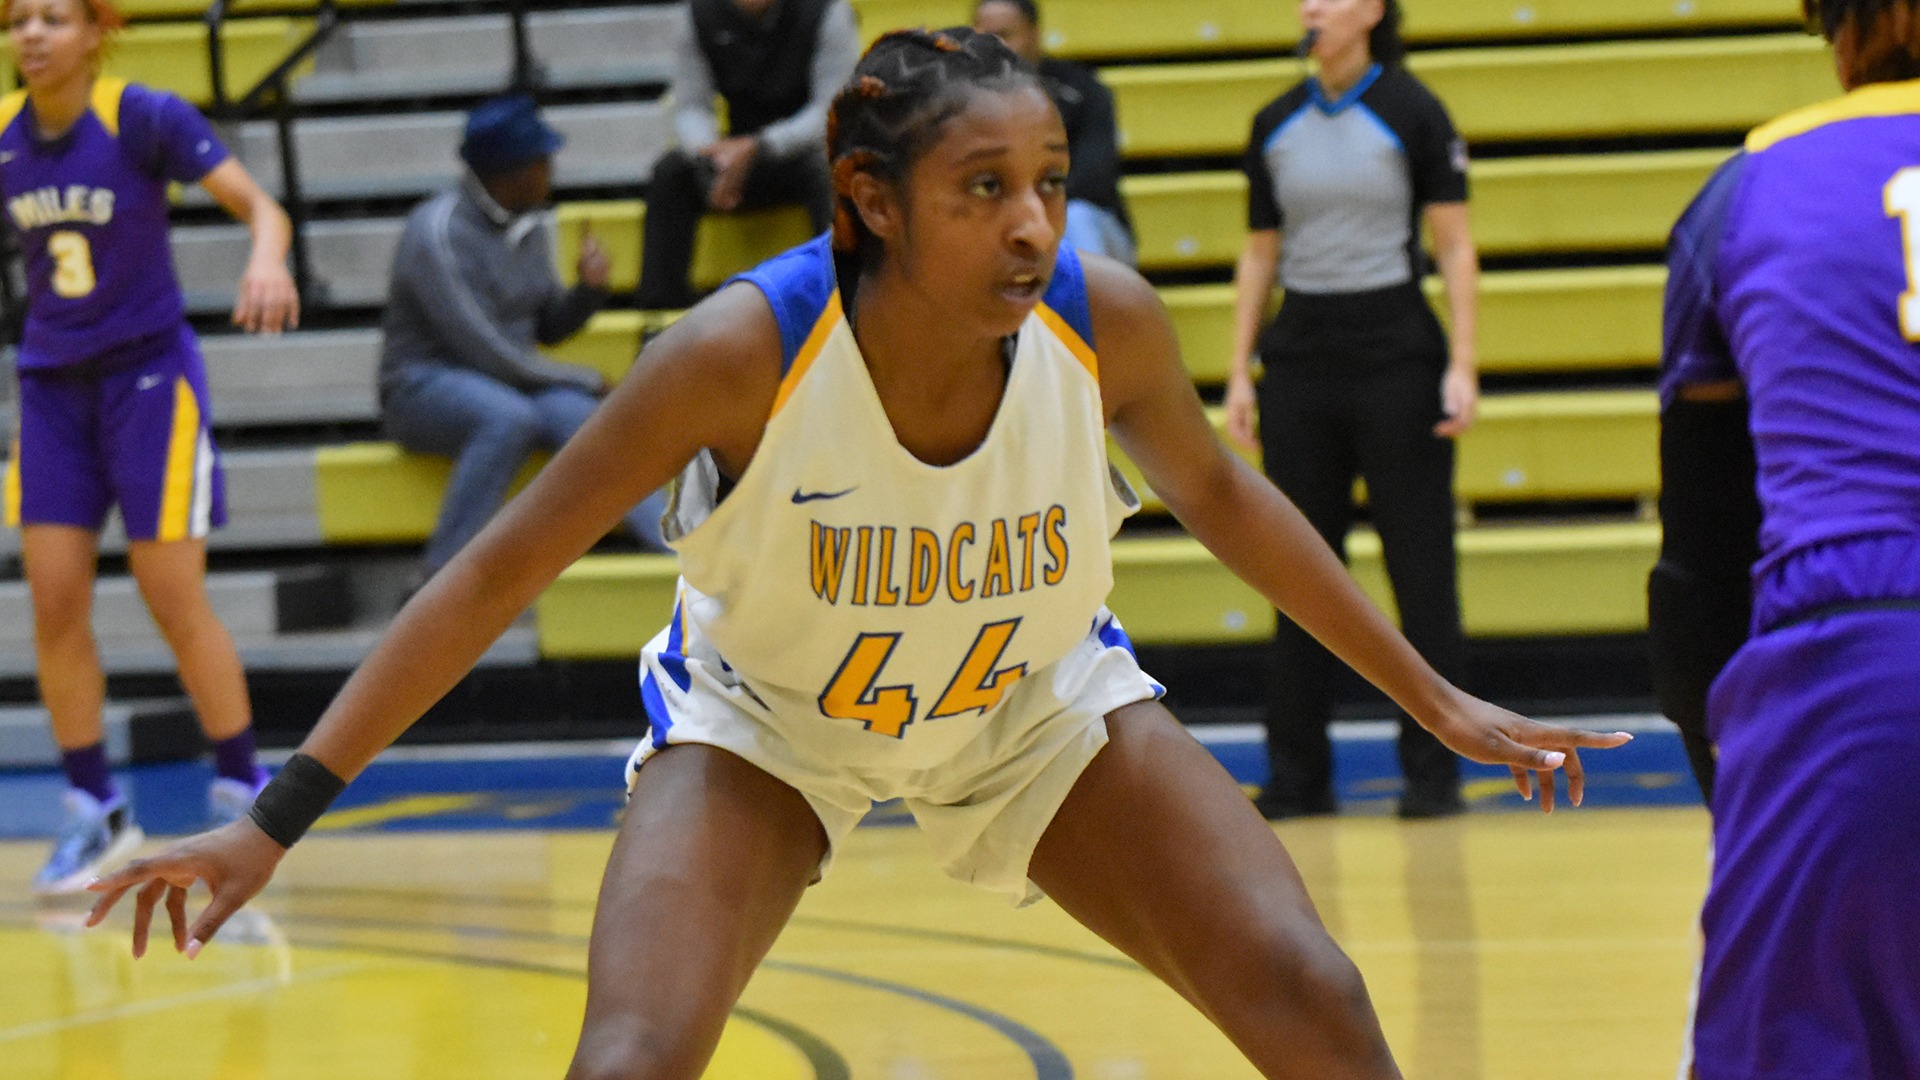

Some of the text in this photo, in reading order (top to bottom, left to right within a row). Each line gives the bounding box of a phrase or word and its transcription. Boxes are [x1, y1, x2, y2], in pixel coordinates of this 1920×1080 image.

[9, 186, 116, 230] MILES
[49, 231, 96, 298] 3
[810, 504, 1069, 606] WILDCATS
[818, 616, 1028, 740] 44
